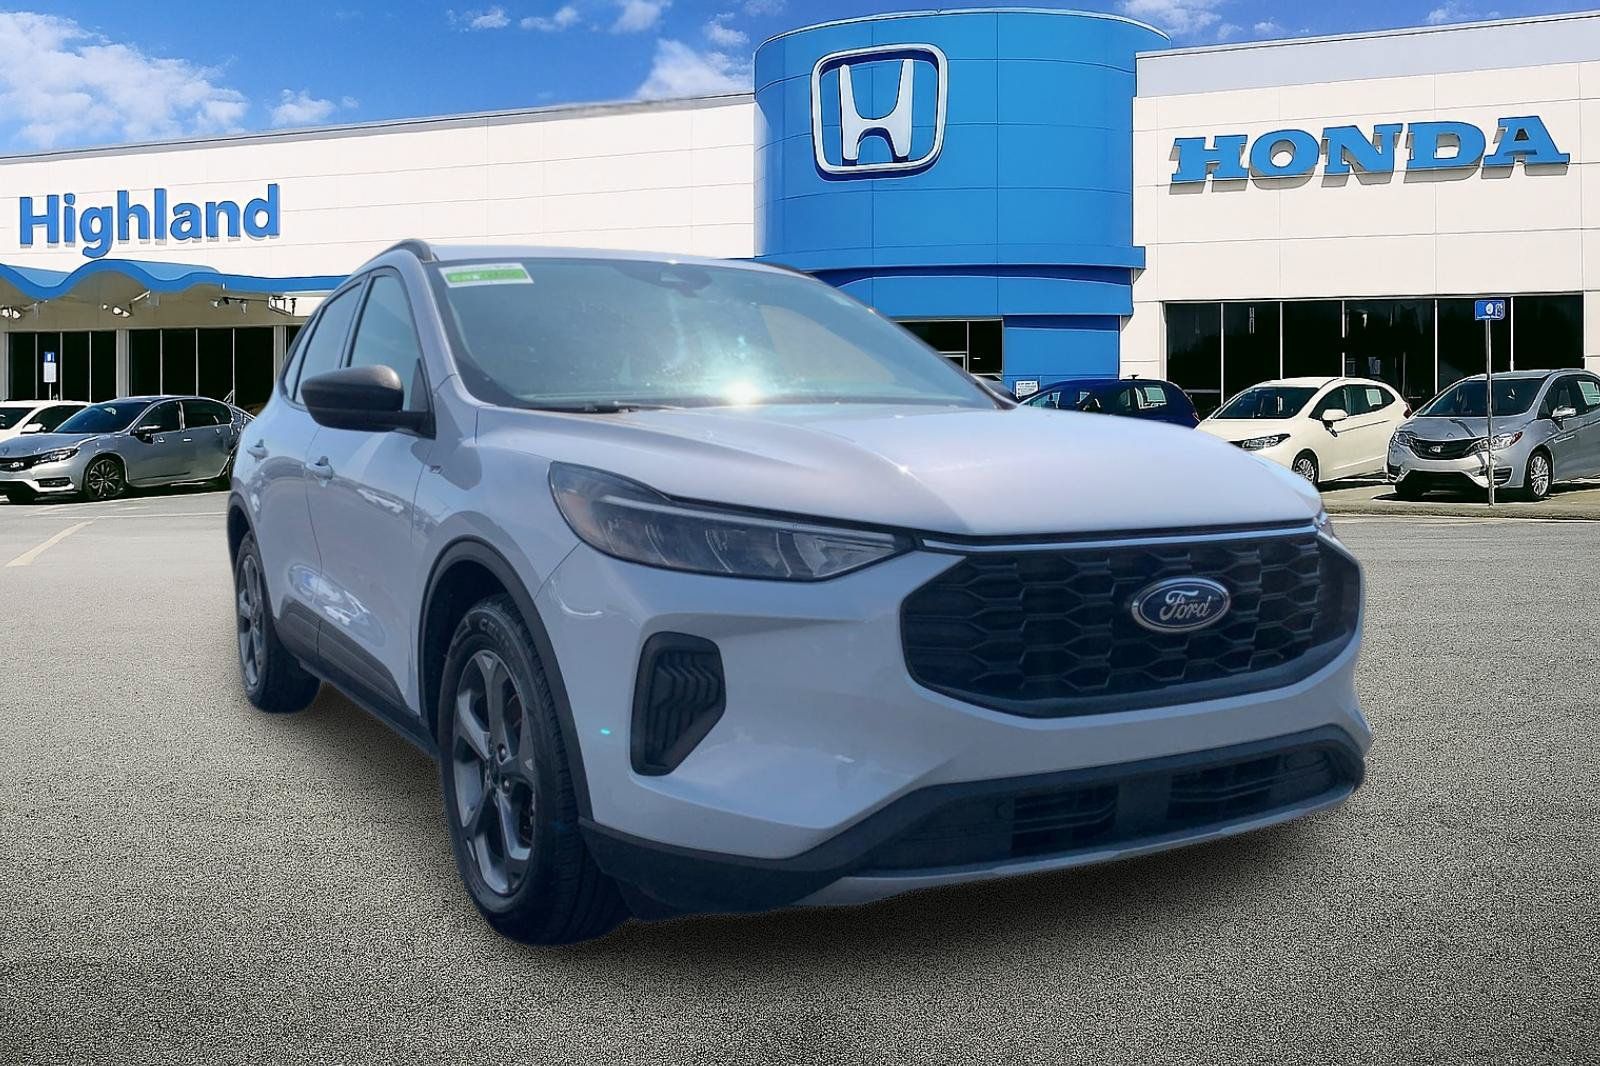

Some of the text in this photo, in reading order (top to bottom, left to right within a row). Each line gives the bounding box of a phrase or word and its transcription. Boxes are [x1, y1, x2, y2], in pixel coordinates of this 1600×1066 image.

[1171, 115, 1571, 184] HONDA
[19, 183, 280, 258] Highland
[1159, 589, 1212, 620] Ford
